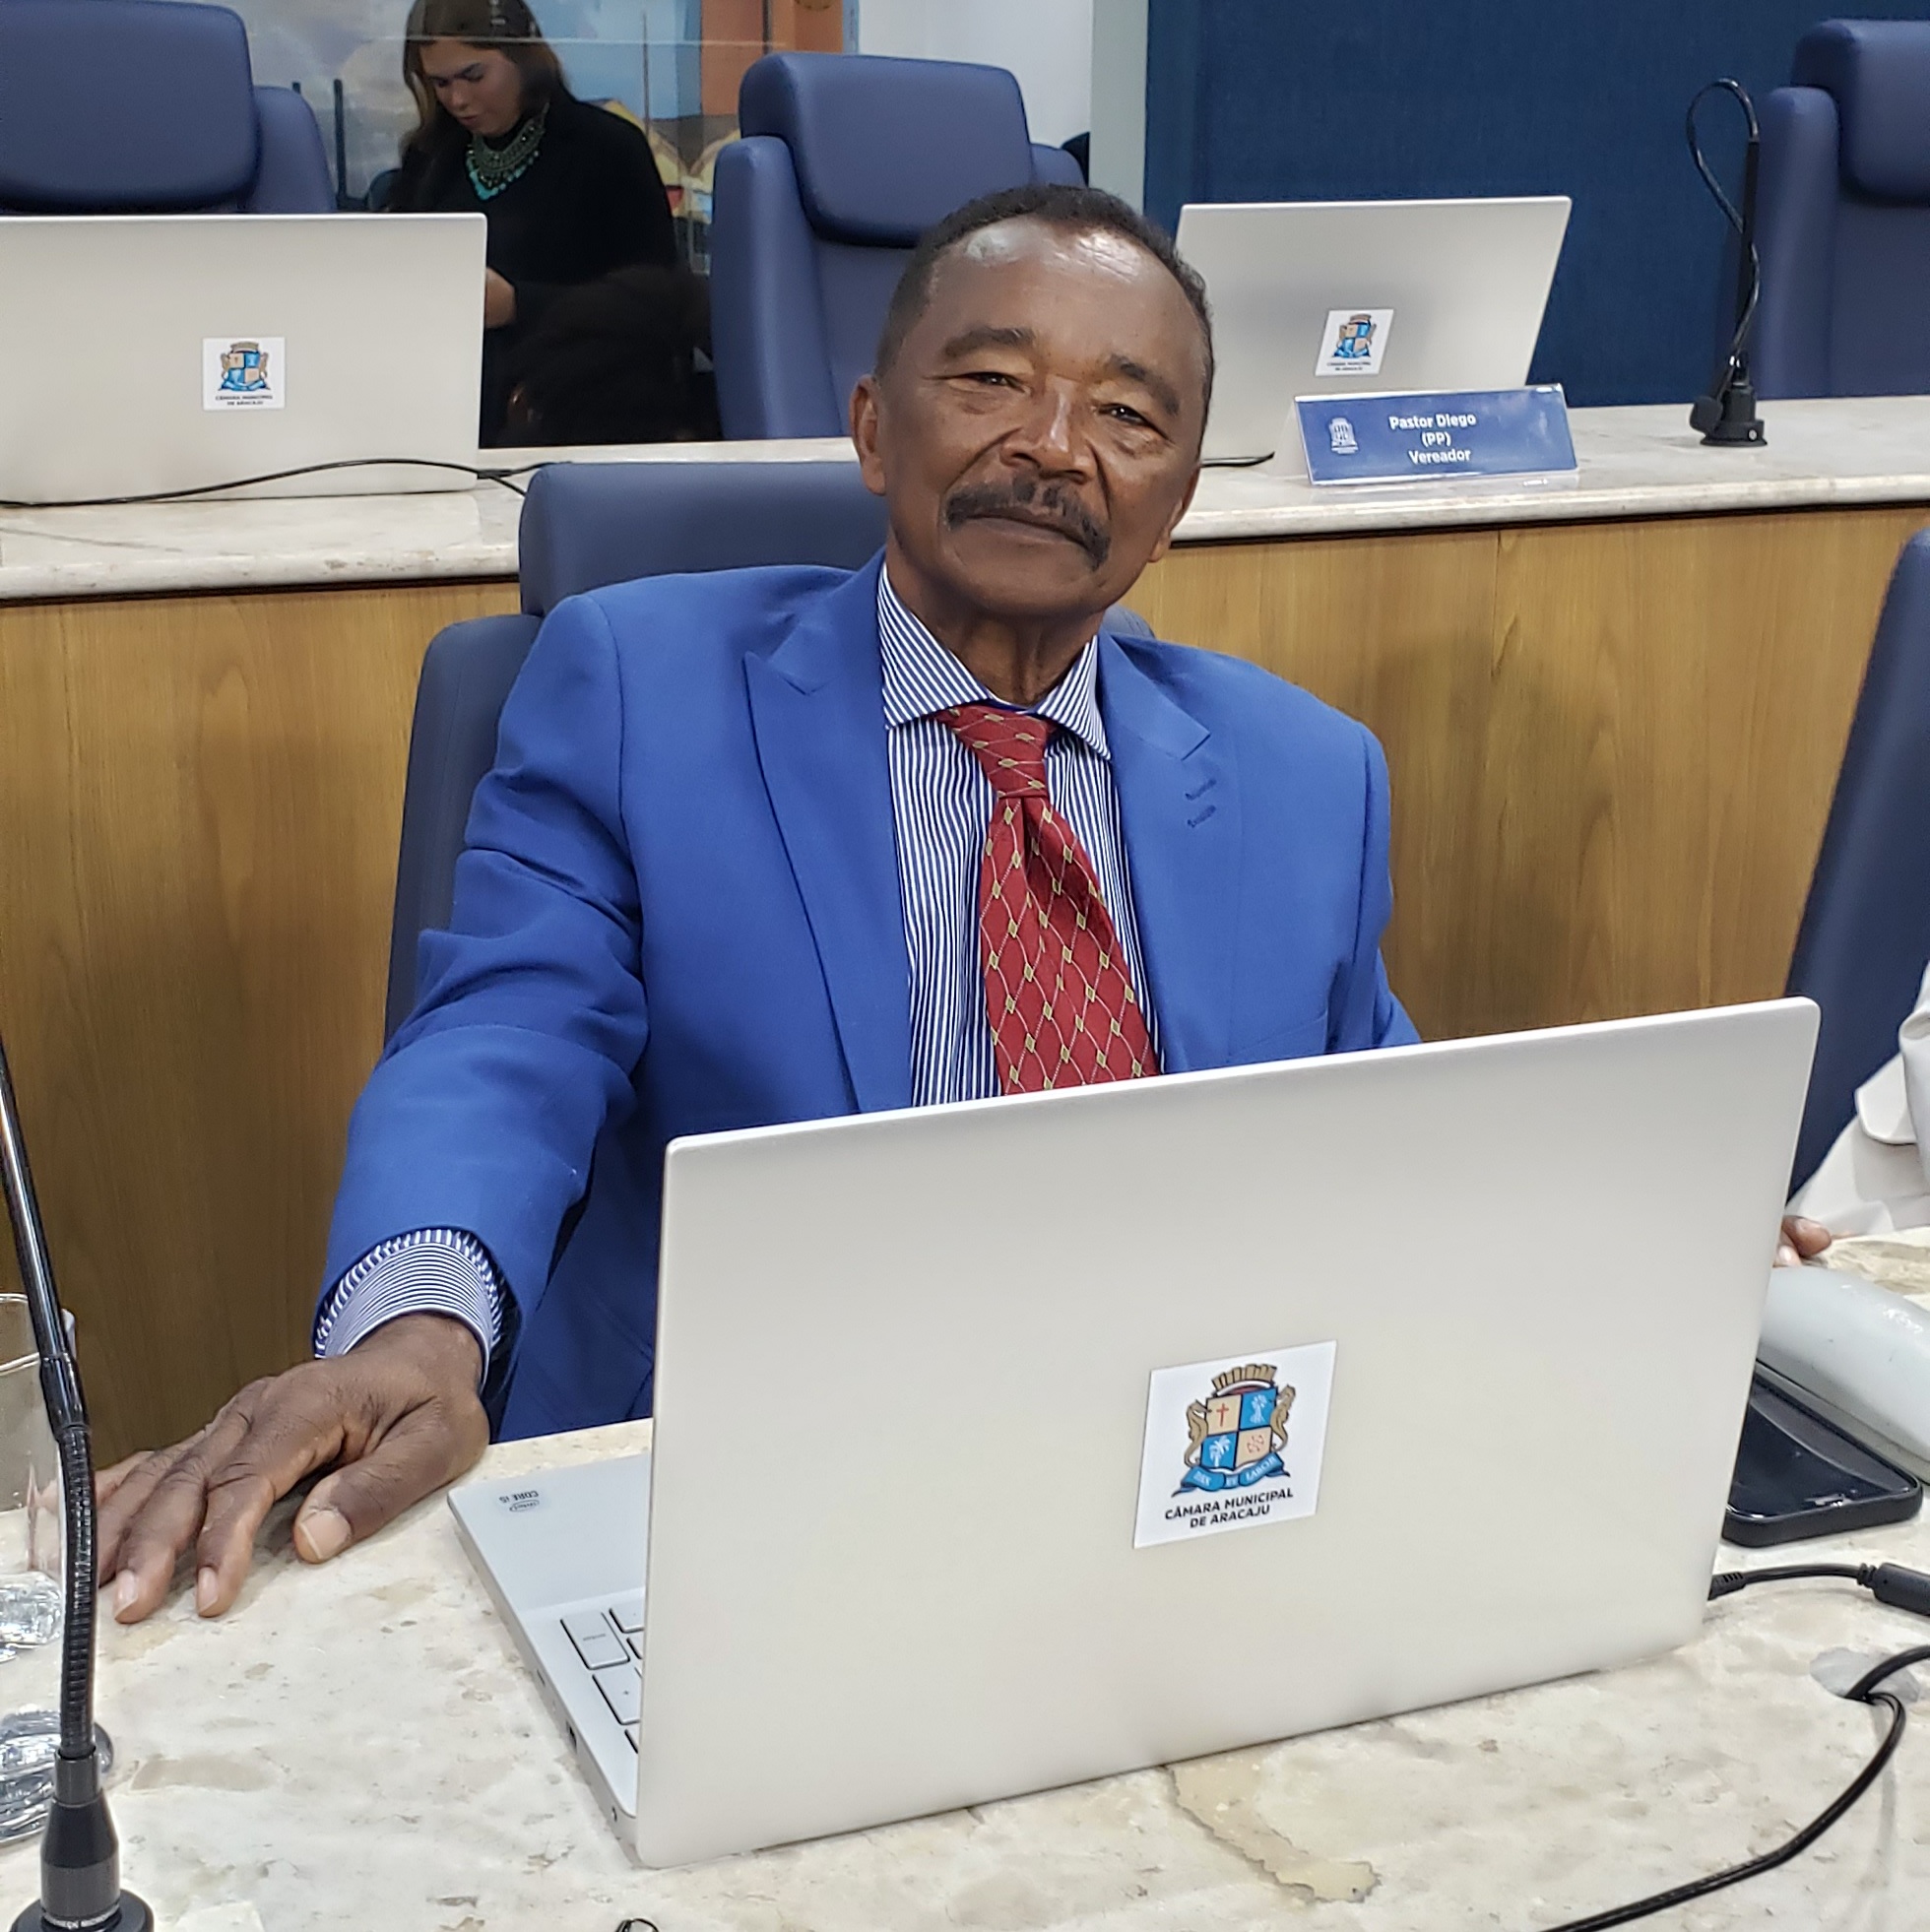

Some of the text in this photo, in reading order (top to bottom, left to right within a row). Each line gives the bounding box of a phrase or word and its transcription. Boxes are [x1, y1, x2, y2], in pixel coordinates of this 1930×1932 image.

[1388, 413, 1477, 430] Pastor Diego
[1421, 431, 1452, 448] (PP)
[1408, 448, 1472, 465] Vereador
[1165, 1488, 1294, 1520] CÂMARA MUNICIPAL
[1190, 1504, 1270, 1528] DE ARACAJU
